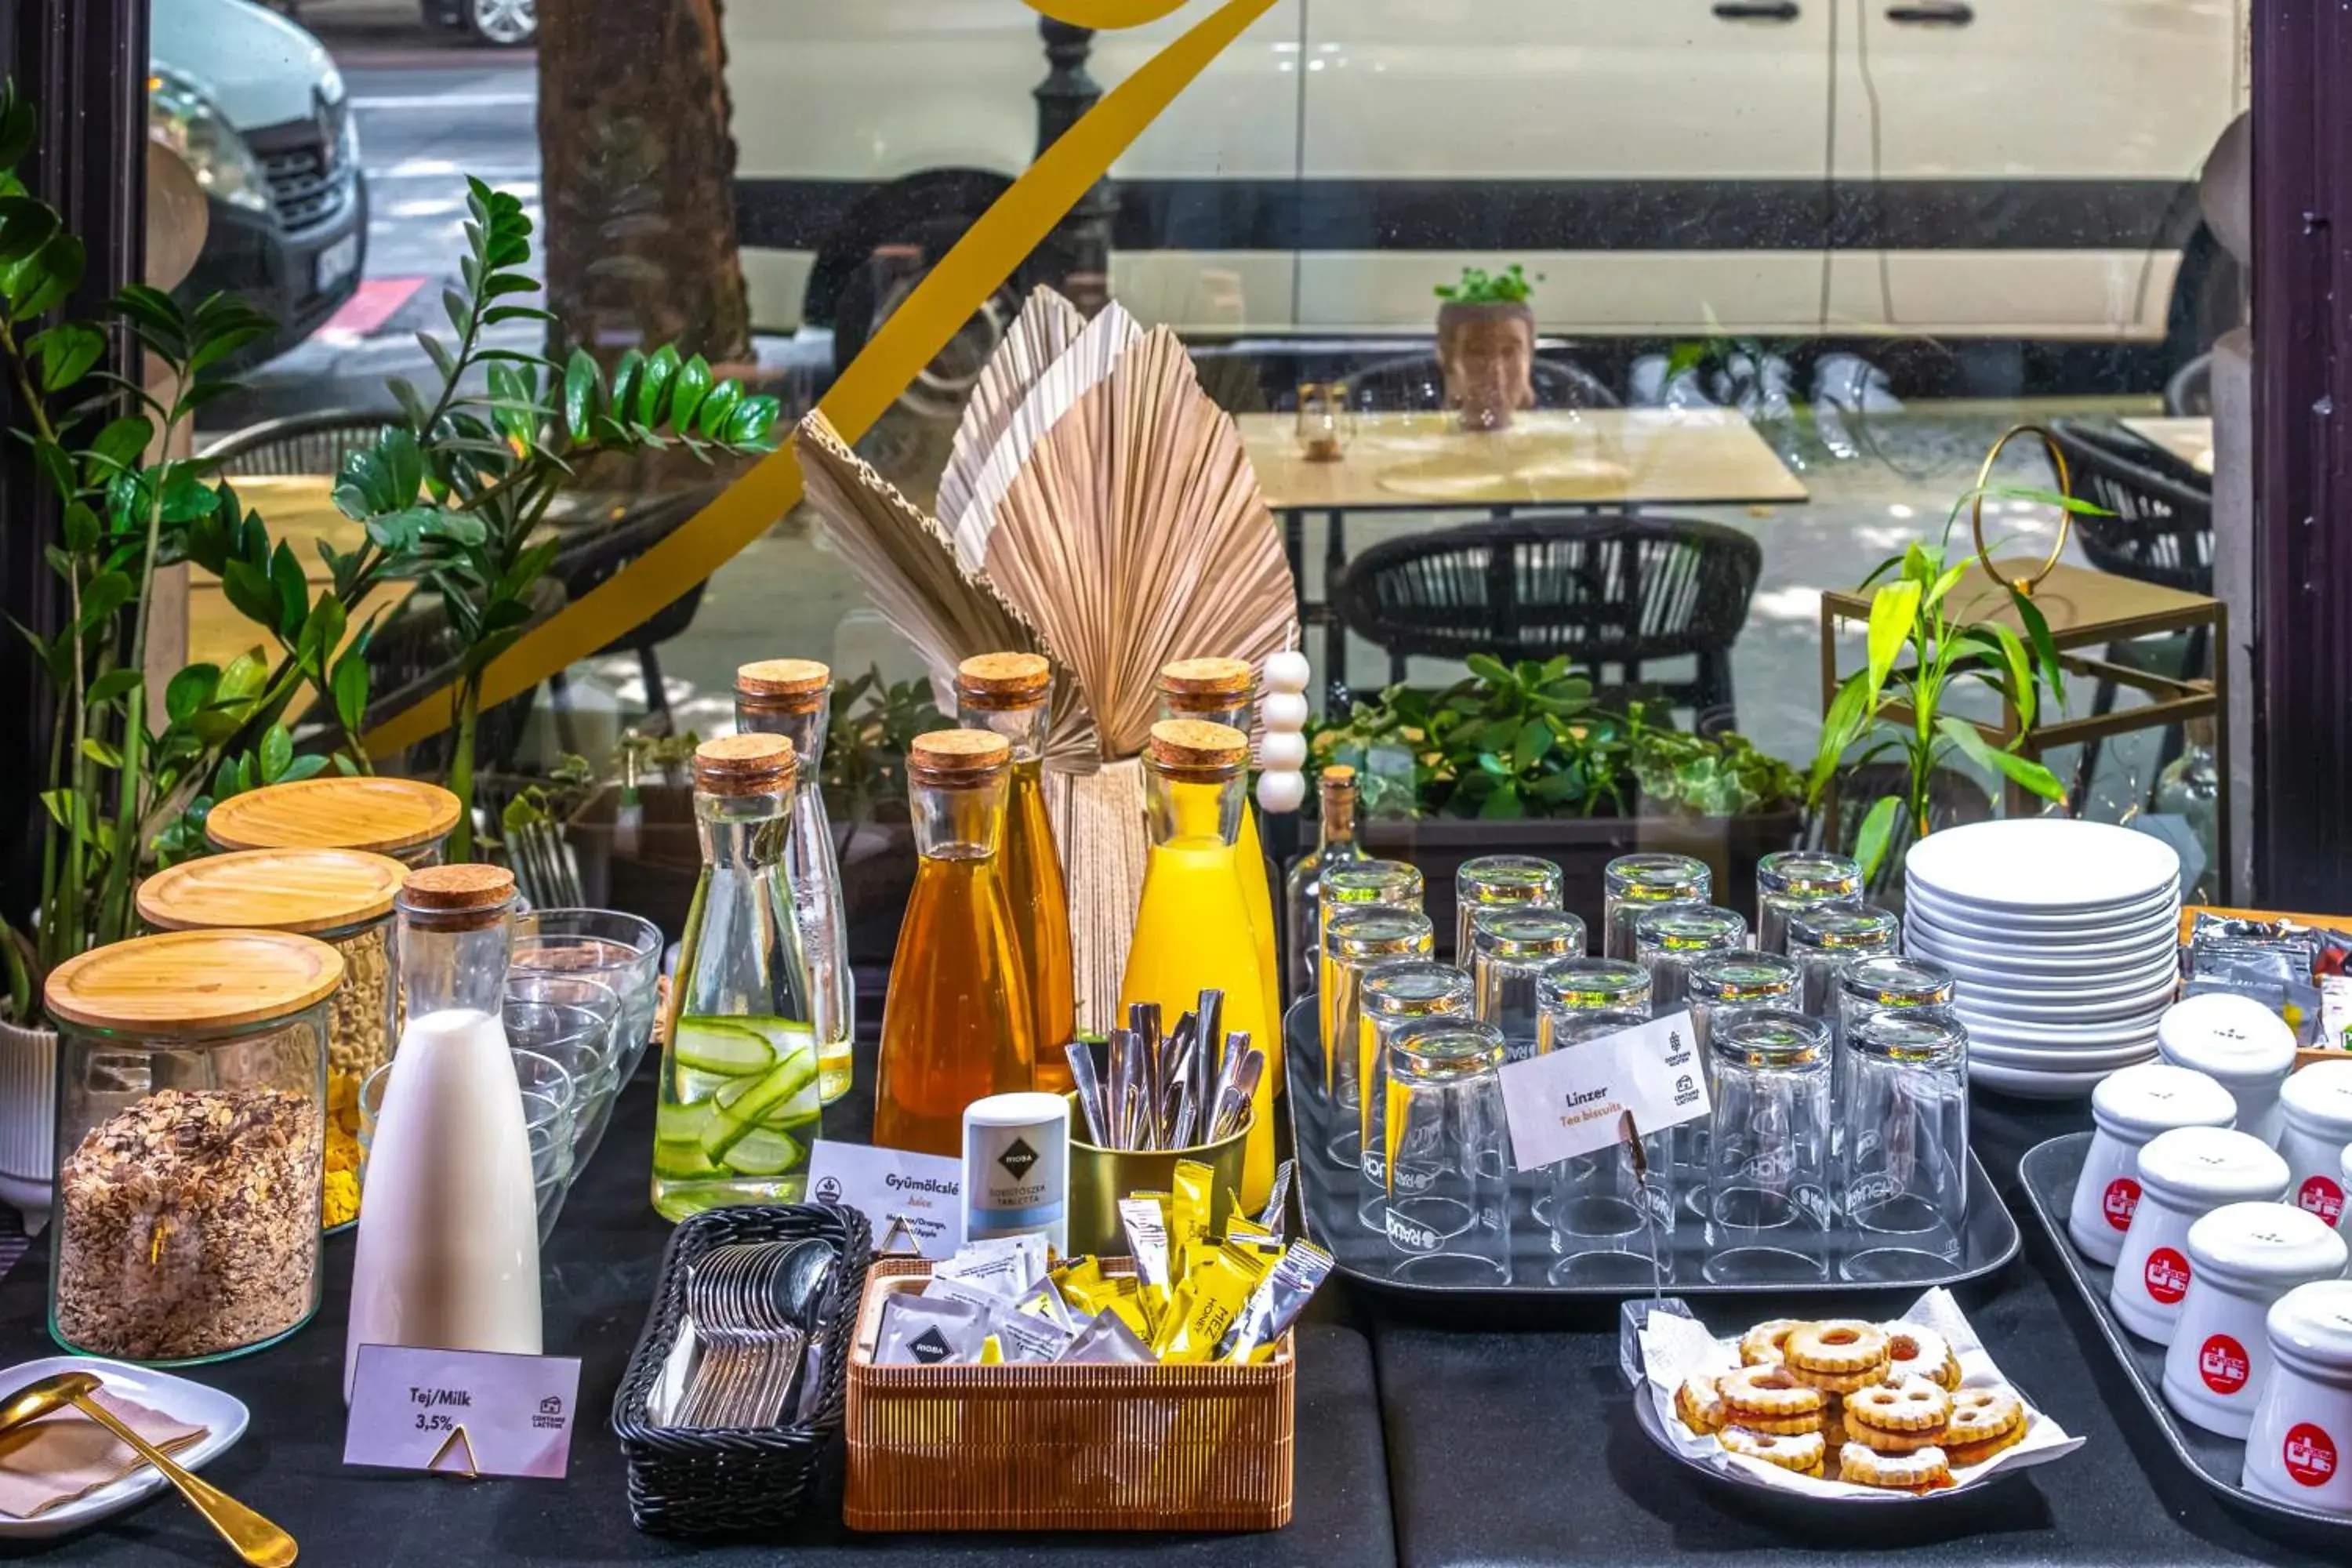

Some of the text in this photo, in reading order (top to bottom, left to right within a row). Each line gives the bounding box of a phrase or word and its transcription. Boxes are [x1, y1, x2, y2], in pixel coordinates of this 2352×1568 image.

[1566, 1087, 1608, 1108] Linzer
[1559, 1115, 1581, 1127] Tea
[409, 1387, 471, 1408] Tej/Milk
[415, 1414, 453, 1432] 3,5%
